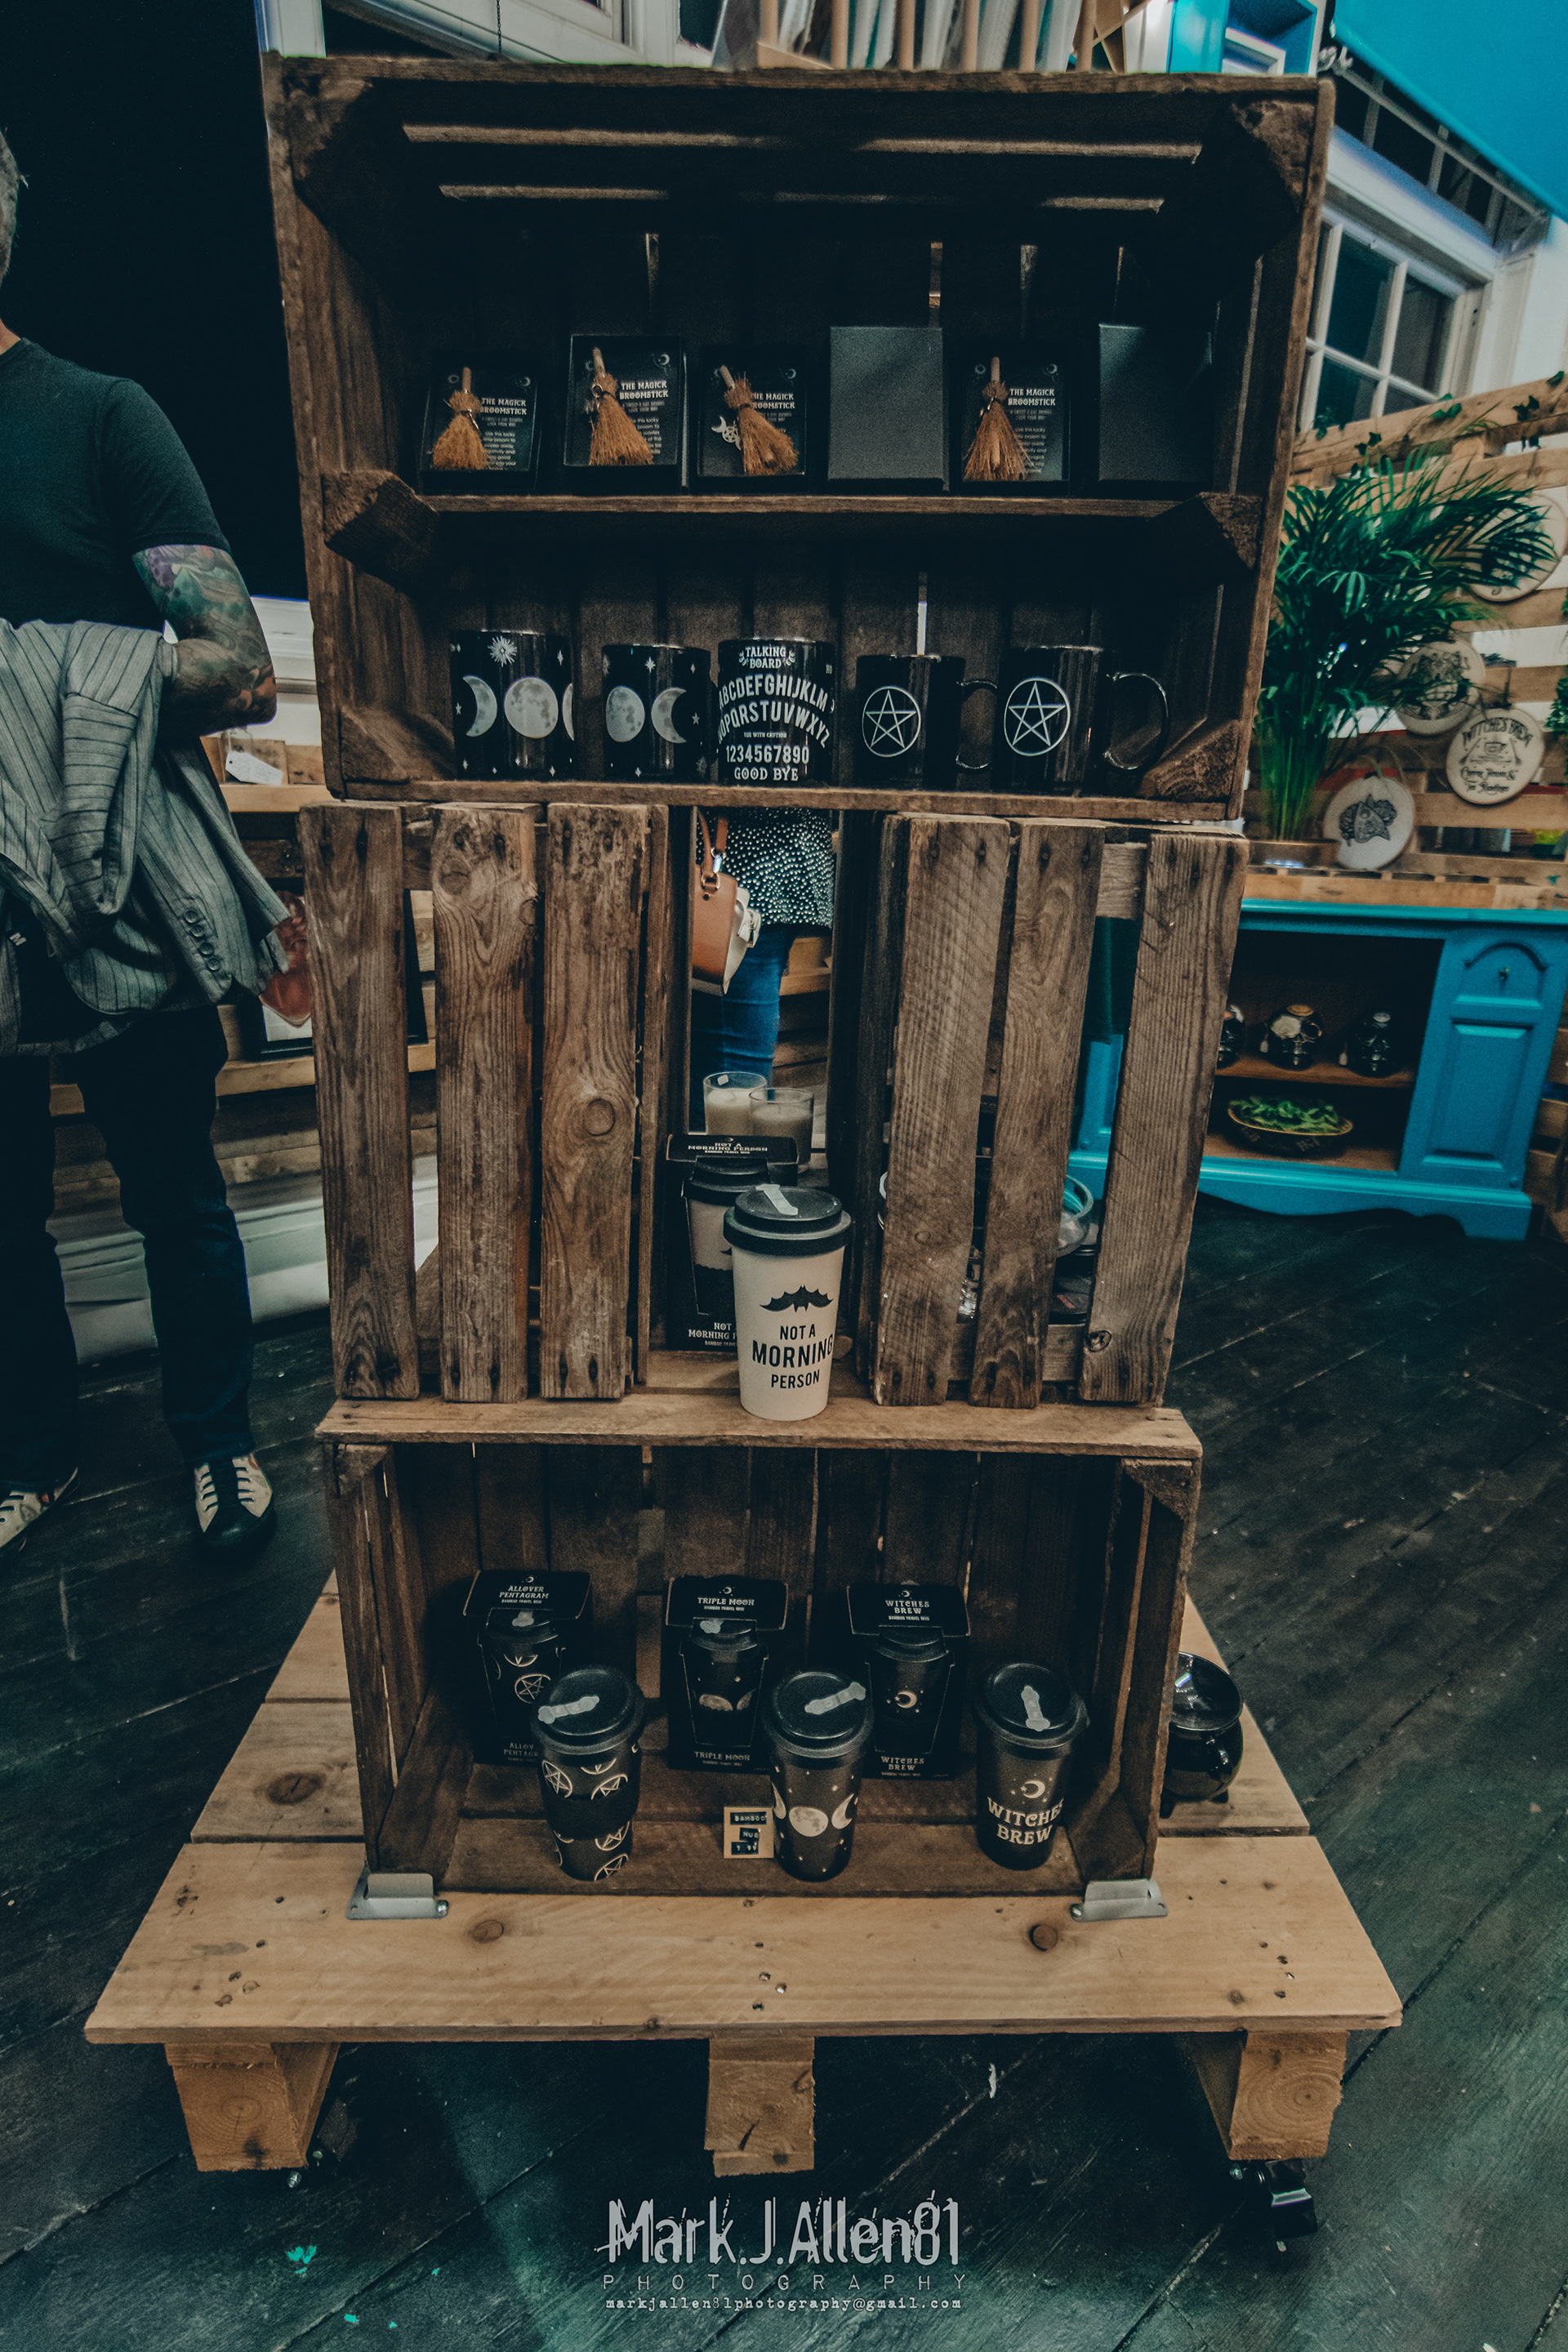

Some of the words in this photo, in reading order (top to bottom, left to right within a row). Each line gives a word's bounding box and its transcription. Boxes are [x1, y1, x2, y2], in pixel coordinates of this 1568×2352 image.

[621, 382, 635, 390] THE
[638, 381, 667, 390] MAGICK
[619, 390, 669, 400] BROOMSTICK
[498, 399, 527, 407] MAGICK
[1008, 398, 1056, 406] BROOMSTICK
[745, 646, 786, 657] TALKING
[750, 658, 782, 669] BOARD
[719, 674, 828, 712] ABCDEFGHIJKLM
[726, 745, 809, 764] 1234567890
[734, 767, 768, 781] GOOD
[773, 766, 799, 781] BYE
[714, 1322, 732, 1331] NOT
[688, 1329, 729, 1339] MORNING
[780, 1325, 806, 1340] NOT
[808, 1324, 816, 1339] A
[752, 1333, 833, 1368] MORNING
[771, 1369, 820, 1389] PERSON
[697, 1597, 727, 1605] TRIPLE
[884, 1600, 929, 1608] WITCHES
[694, 1751, 723, 1760] TRIPLE
[881, 1756, 924, 1764] WITCHES
[996, 1824, 1053, 1845] BREW
